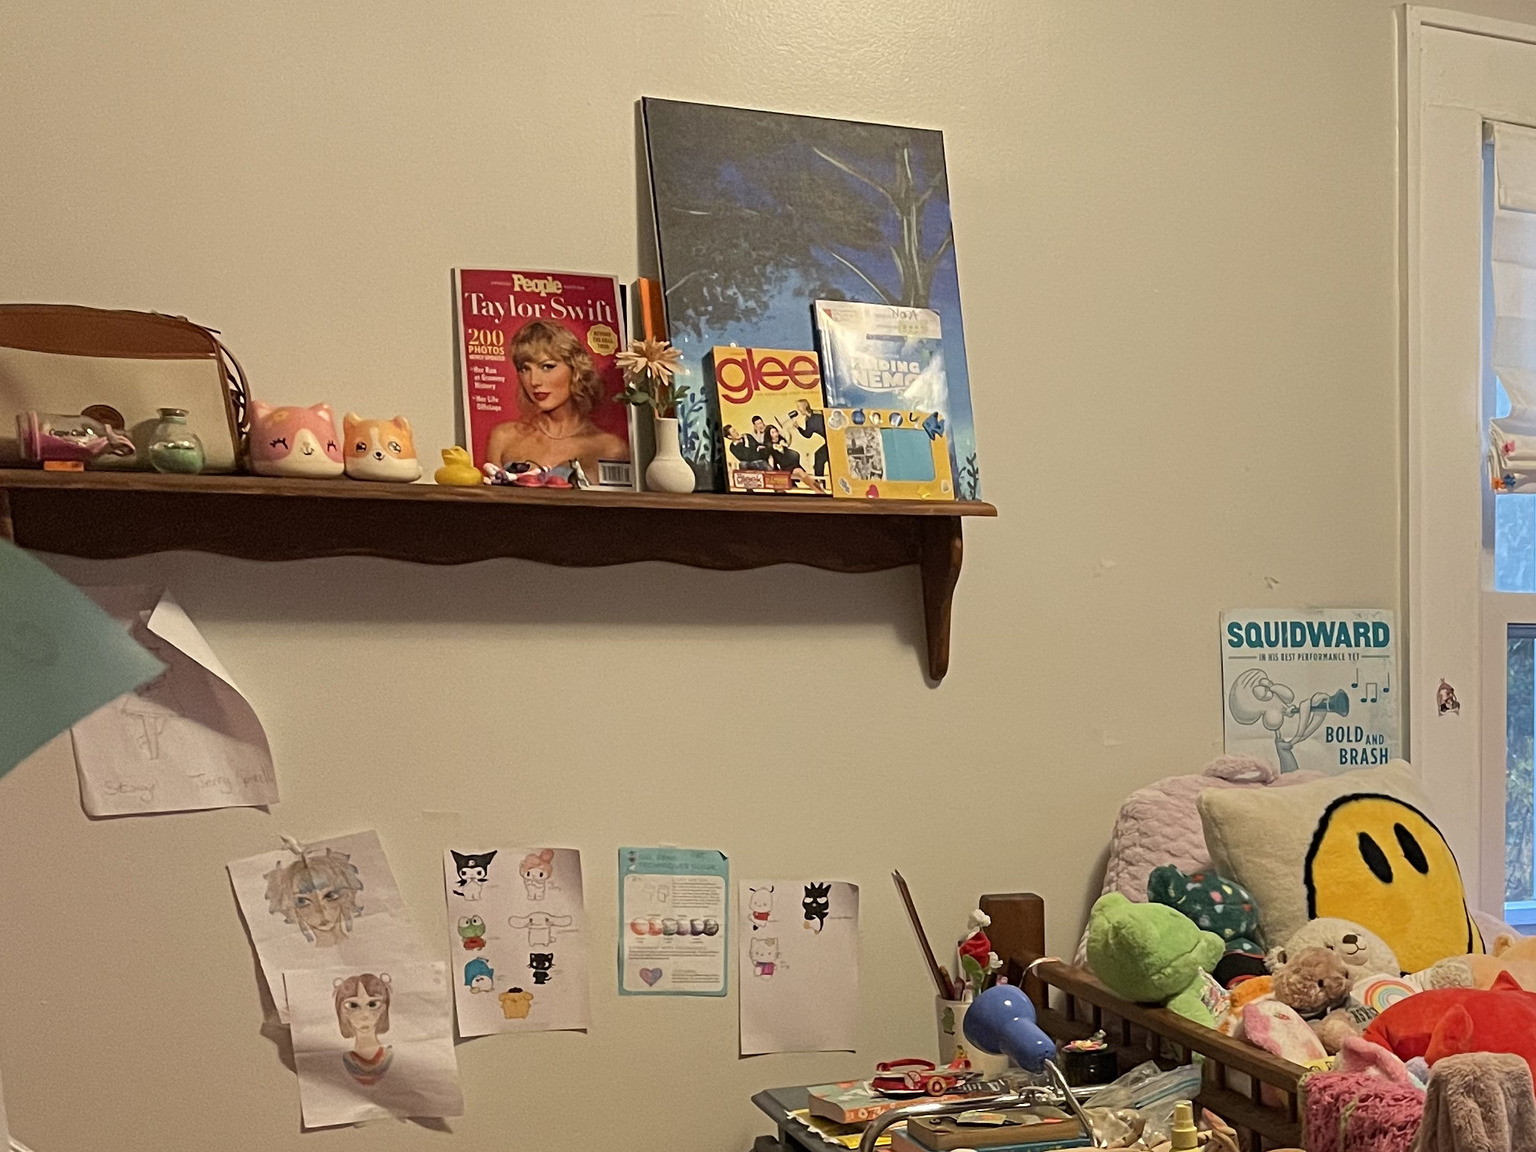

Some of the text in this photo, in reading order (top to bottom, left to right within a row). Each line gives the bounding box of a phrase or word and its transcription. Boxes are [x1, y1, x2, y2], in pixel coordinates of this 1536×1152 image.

[512, 273, 563, 297] People
[464, 292, 615, 324] Taylor Swift
[468, 328, 504, 347] 200
[469, 346, 505, 356] PHOTOS
[852, 357, 920, 374] DING
[716, 348, 821, 404] glee
[1227, 621, 1390, 649] SQUIDWARD
[1258, 652, 1360, 662] IN HIS BEST PERFORMANCE YET
[1325, 726, 1384, 746] BOLD AND
[1339, 748, 1388, 765] BRASH
